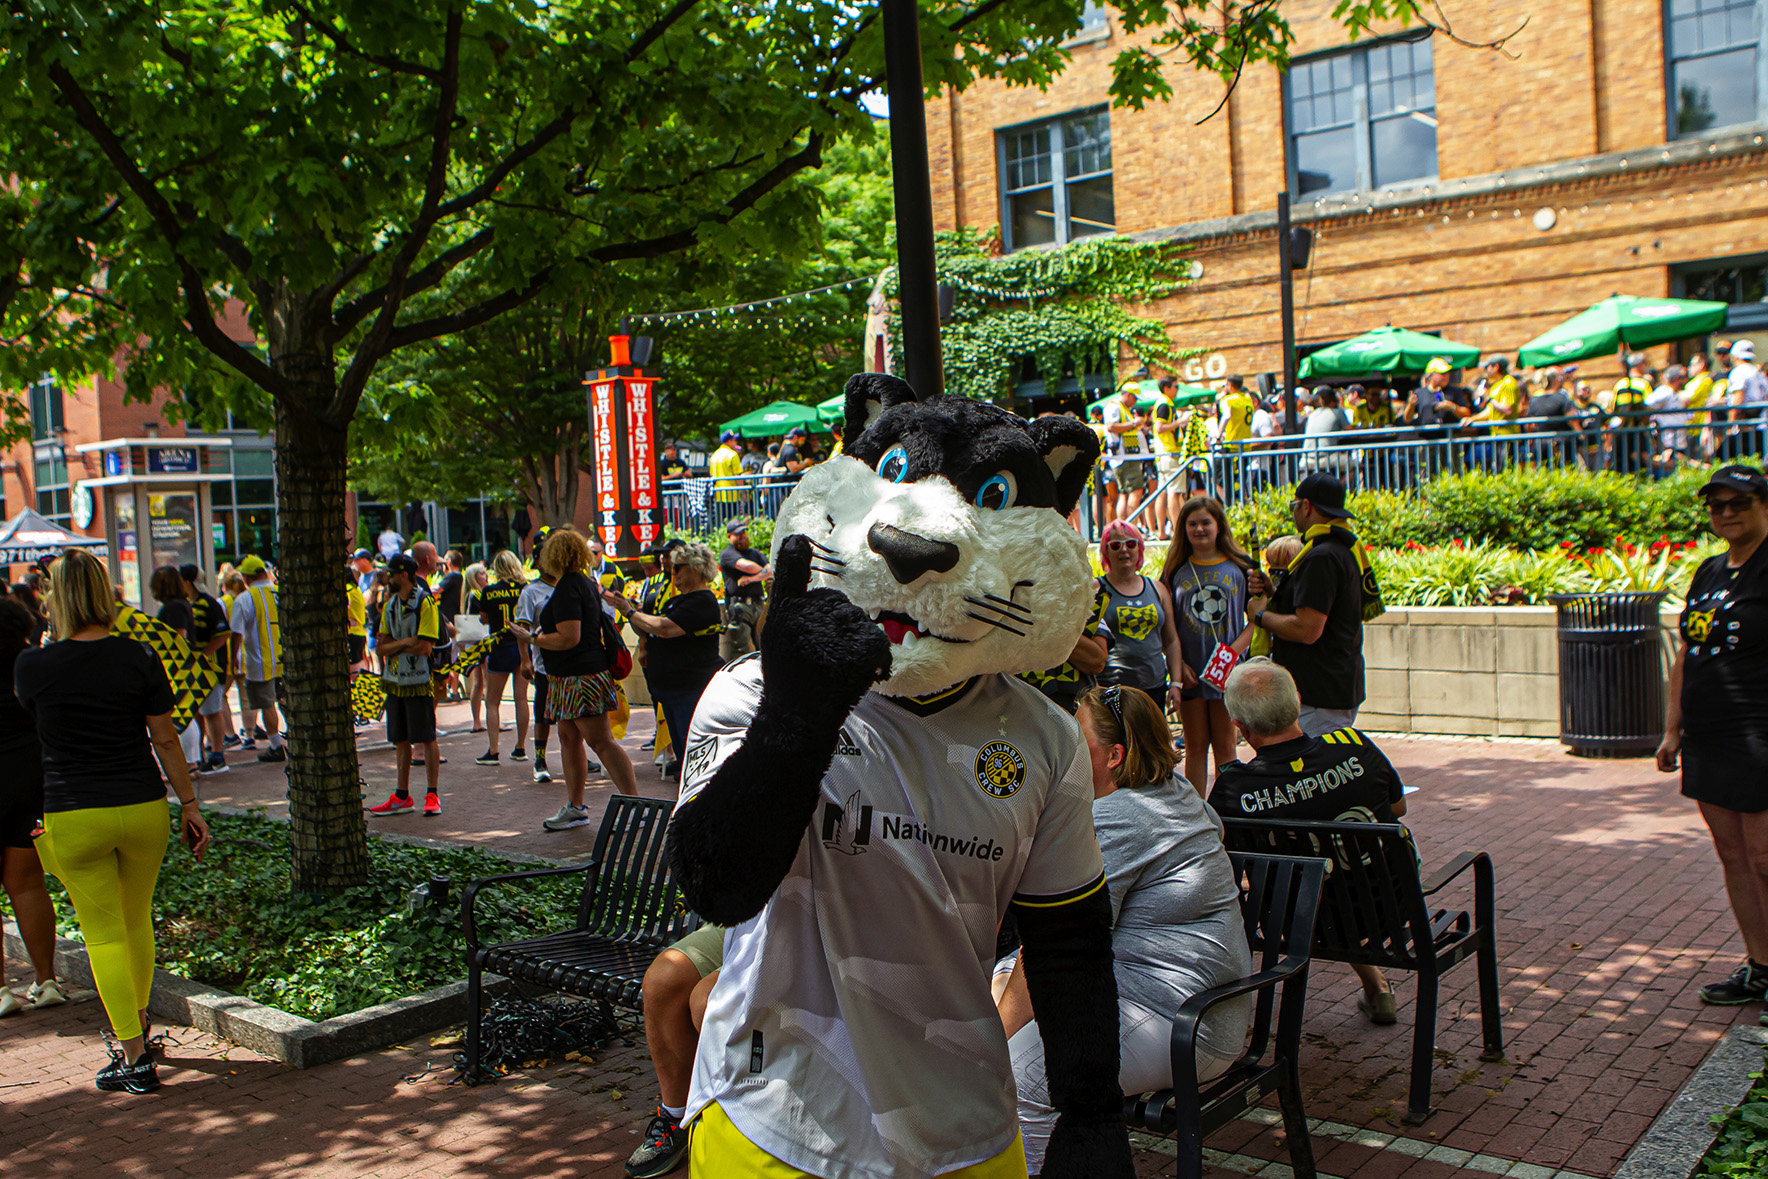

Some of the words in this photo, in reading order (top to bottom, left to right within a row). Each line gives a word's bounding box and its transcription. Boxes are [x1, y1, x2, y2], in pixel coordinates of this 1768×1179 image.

[1184, 353, 1227, 382] GO
[595, 384, 613, 492] WHISTLE
[630, 383, 650, 490] WHISTLE
[602, 493, 615, 509] &
[637, 492, 651, 507] &
[602, 510, 617, 558] KEG
[486, 588, 521, 600] DONATE
[689, 747, 706, 763] MLS
[980, 744, 1024, 769] COLUMBUS
[978, 772, 1002, 796] CREW
[1008, 780, 1020, 793] SC
[1240, 756, 1365, 813] CHAMPIONS
